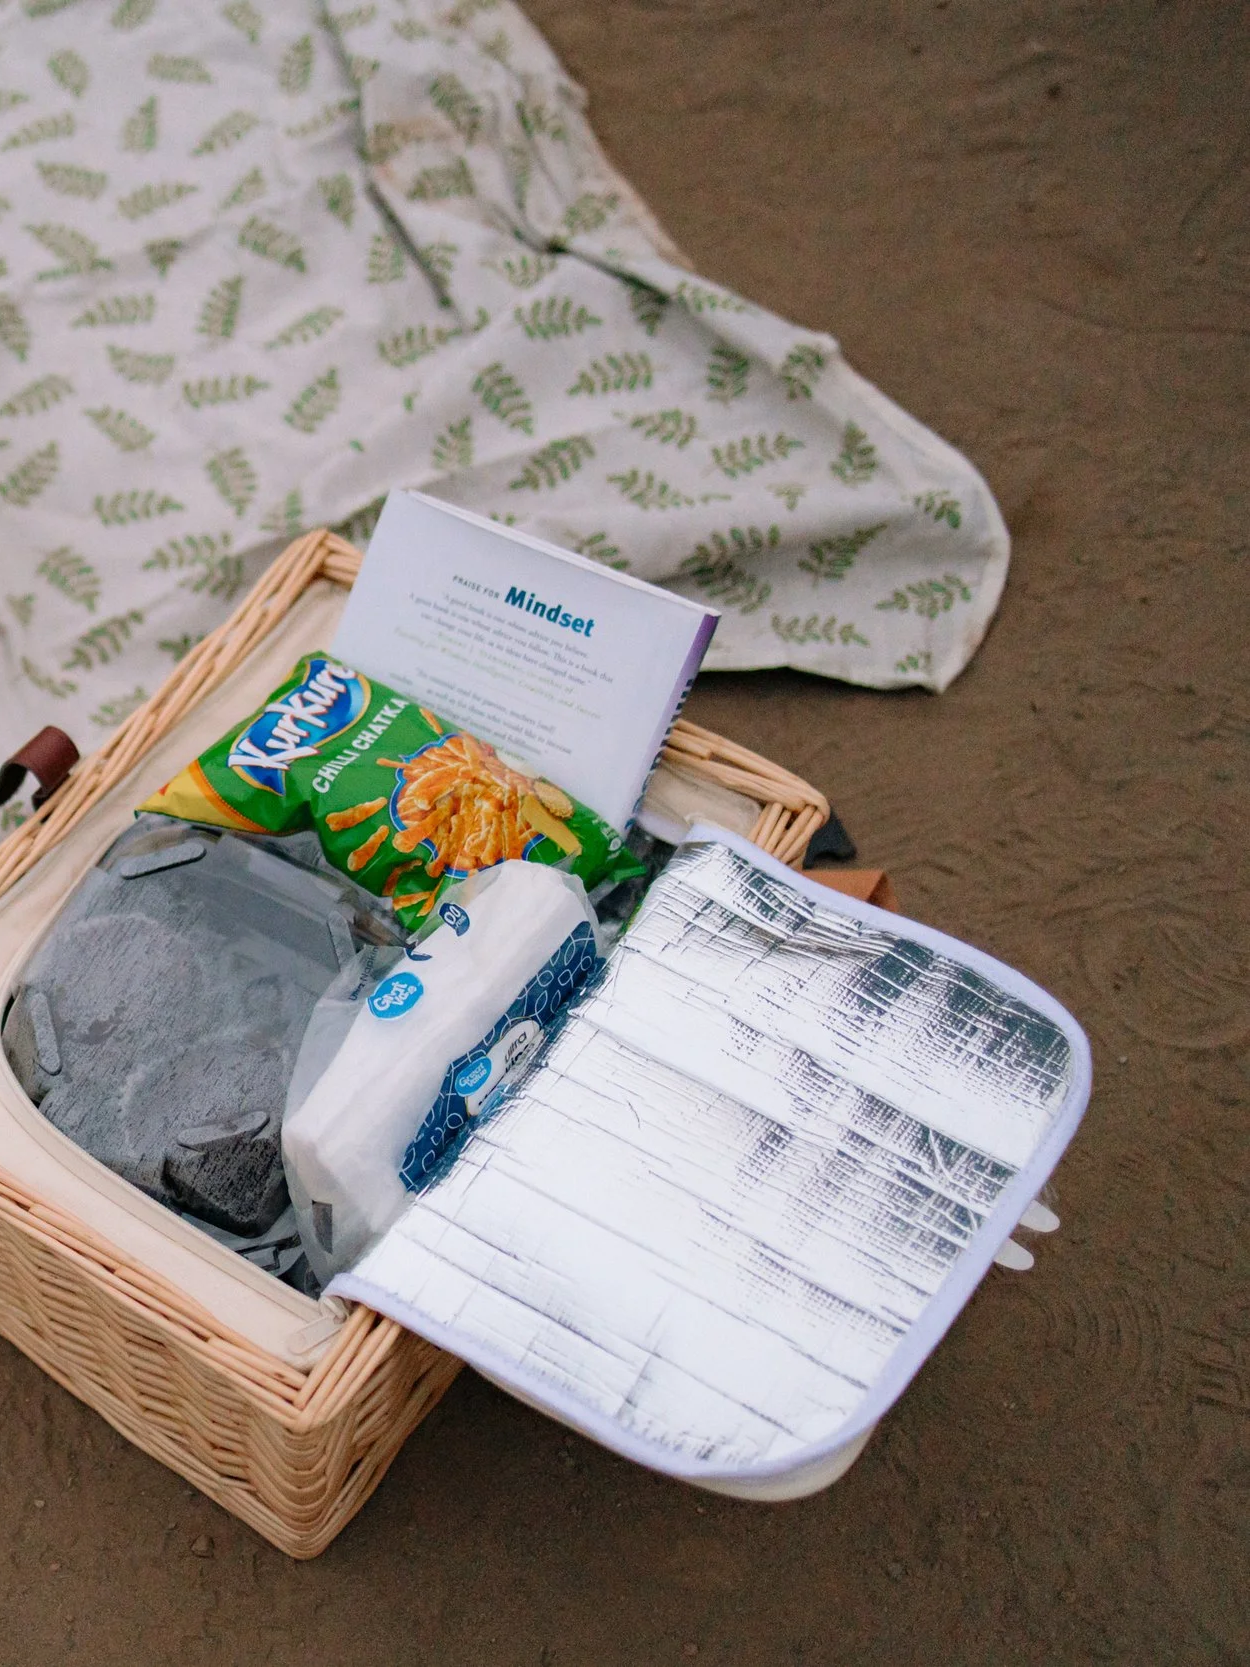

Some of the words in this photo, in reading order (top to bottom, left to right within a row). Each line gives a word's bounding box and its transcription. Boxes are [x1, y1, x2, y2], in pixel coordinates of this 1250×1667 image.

[453, 574, 481, 594] PRAISE
[483, 587, 501, 600] FOR
[504, 586, 595, 639] Mindset
[537, 660, 567, 679] changed
[552, 651, 567, 664] This
[580, 663, 598, 677] book
[598, 671, 614, 684] that
[228, 662, 358, 770] Kurkure
[312, 750, 360, 794] CHILLI
[352, 697, 410, 751] CHATKA
[505, 1031, 527, 1064] ultra
[459, 1062, 485, 1087] Great
